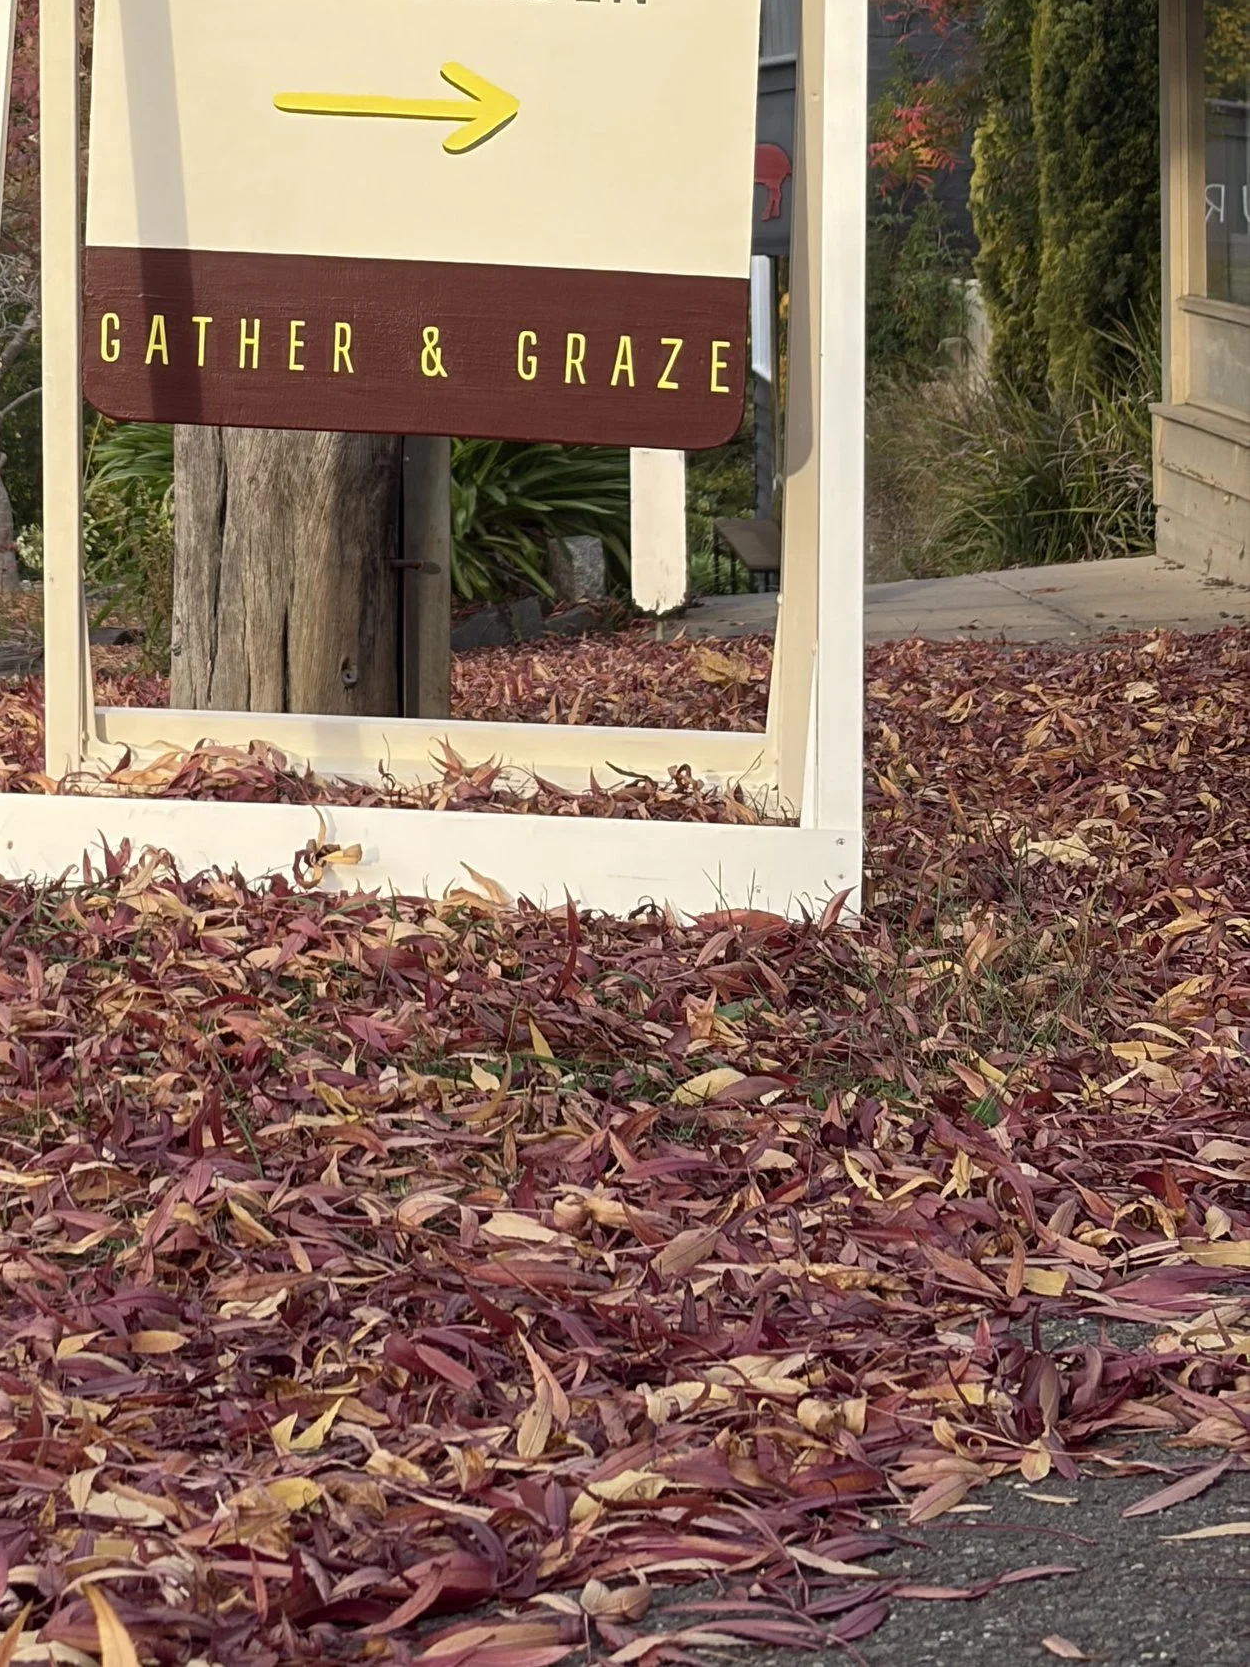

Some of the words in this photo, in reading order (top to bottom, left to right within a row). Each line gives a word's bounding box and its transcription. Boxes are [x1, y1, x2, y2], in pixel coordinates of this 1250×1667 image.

[100, 312, 355, 375] GATHER
[420, 325, 449, 379] &
[517, 330, 731, 394] GRAZE
